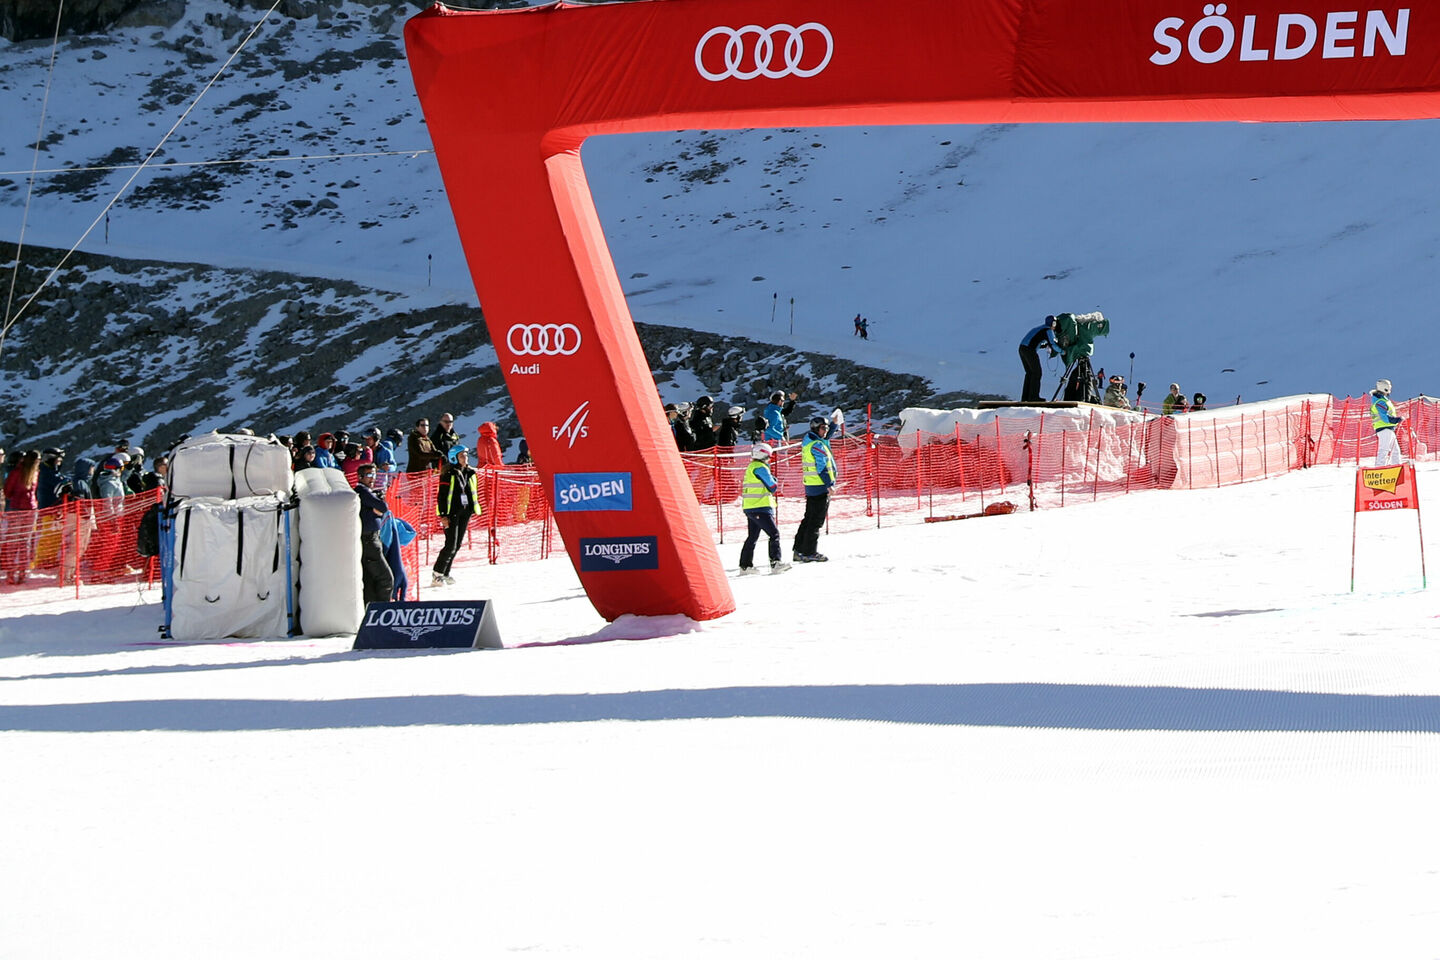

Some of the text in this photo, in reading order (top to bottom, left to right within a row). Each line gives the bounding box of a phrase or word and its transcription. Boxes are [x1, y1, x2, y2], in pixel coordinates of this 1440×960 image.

[1149, 3, 1411, 66] SÖLDEN
[510, 363, 540, 375] Audi
[1368, 477, 1396, 486] wetten
[560, 479, 625, 505] SÖLDEN
[1368, 500, 1404, 510] SÖLDEN
[584, 542, 650, 556] LONGINES
[365, 607, 476, 627] LONGINES
